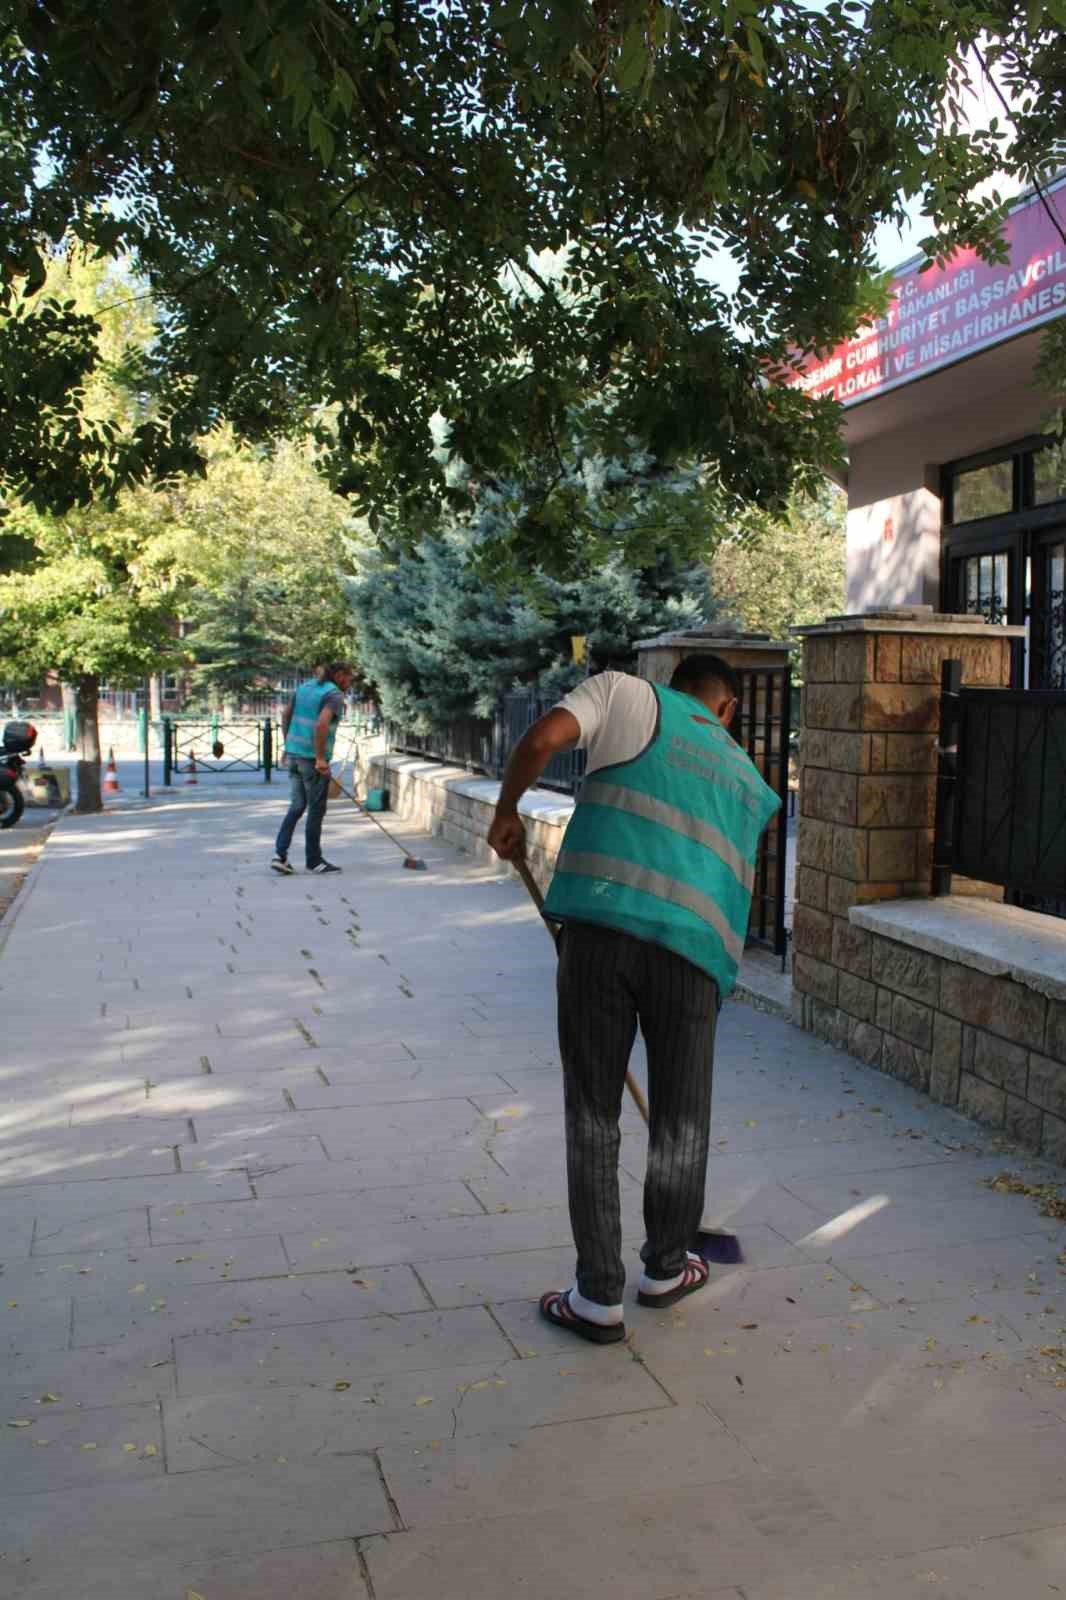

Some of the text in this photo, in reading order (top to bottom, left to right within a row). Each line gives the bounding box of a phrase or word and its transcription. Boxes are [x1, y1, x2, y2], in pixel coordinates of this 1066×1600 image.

[899, 269, 975, 320] BAKANLIĞI
[846, 304, 950, 369] CUMHURİYET
[895, 349, 915, 372] VE
